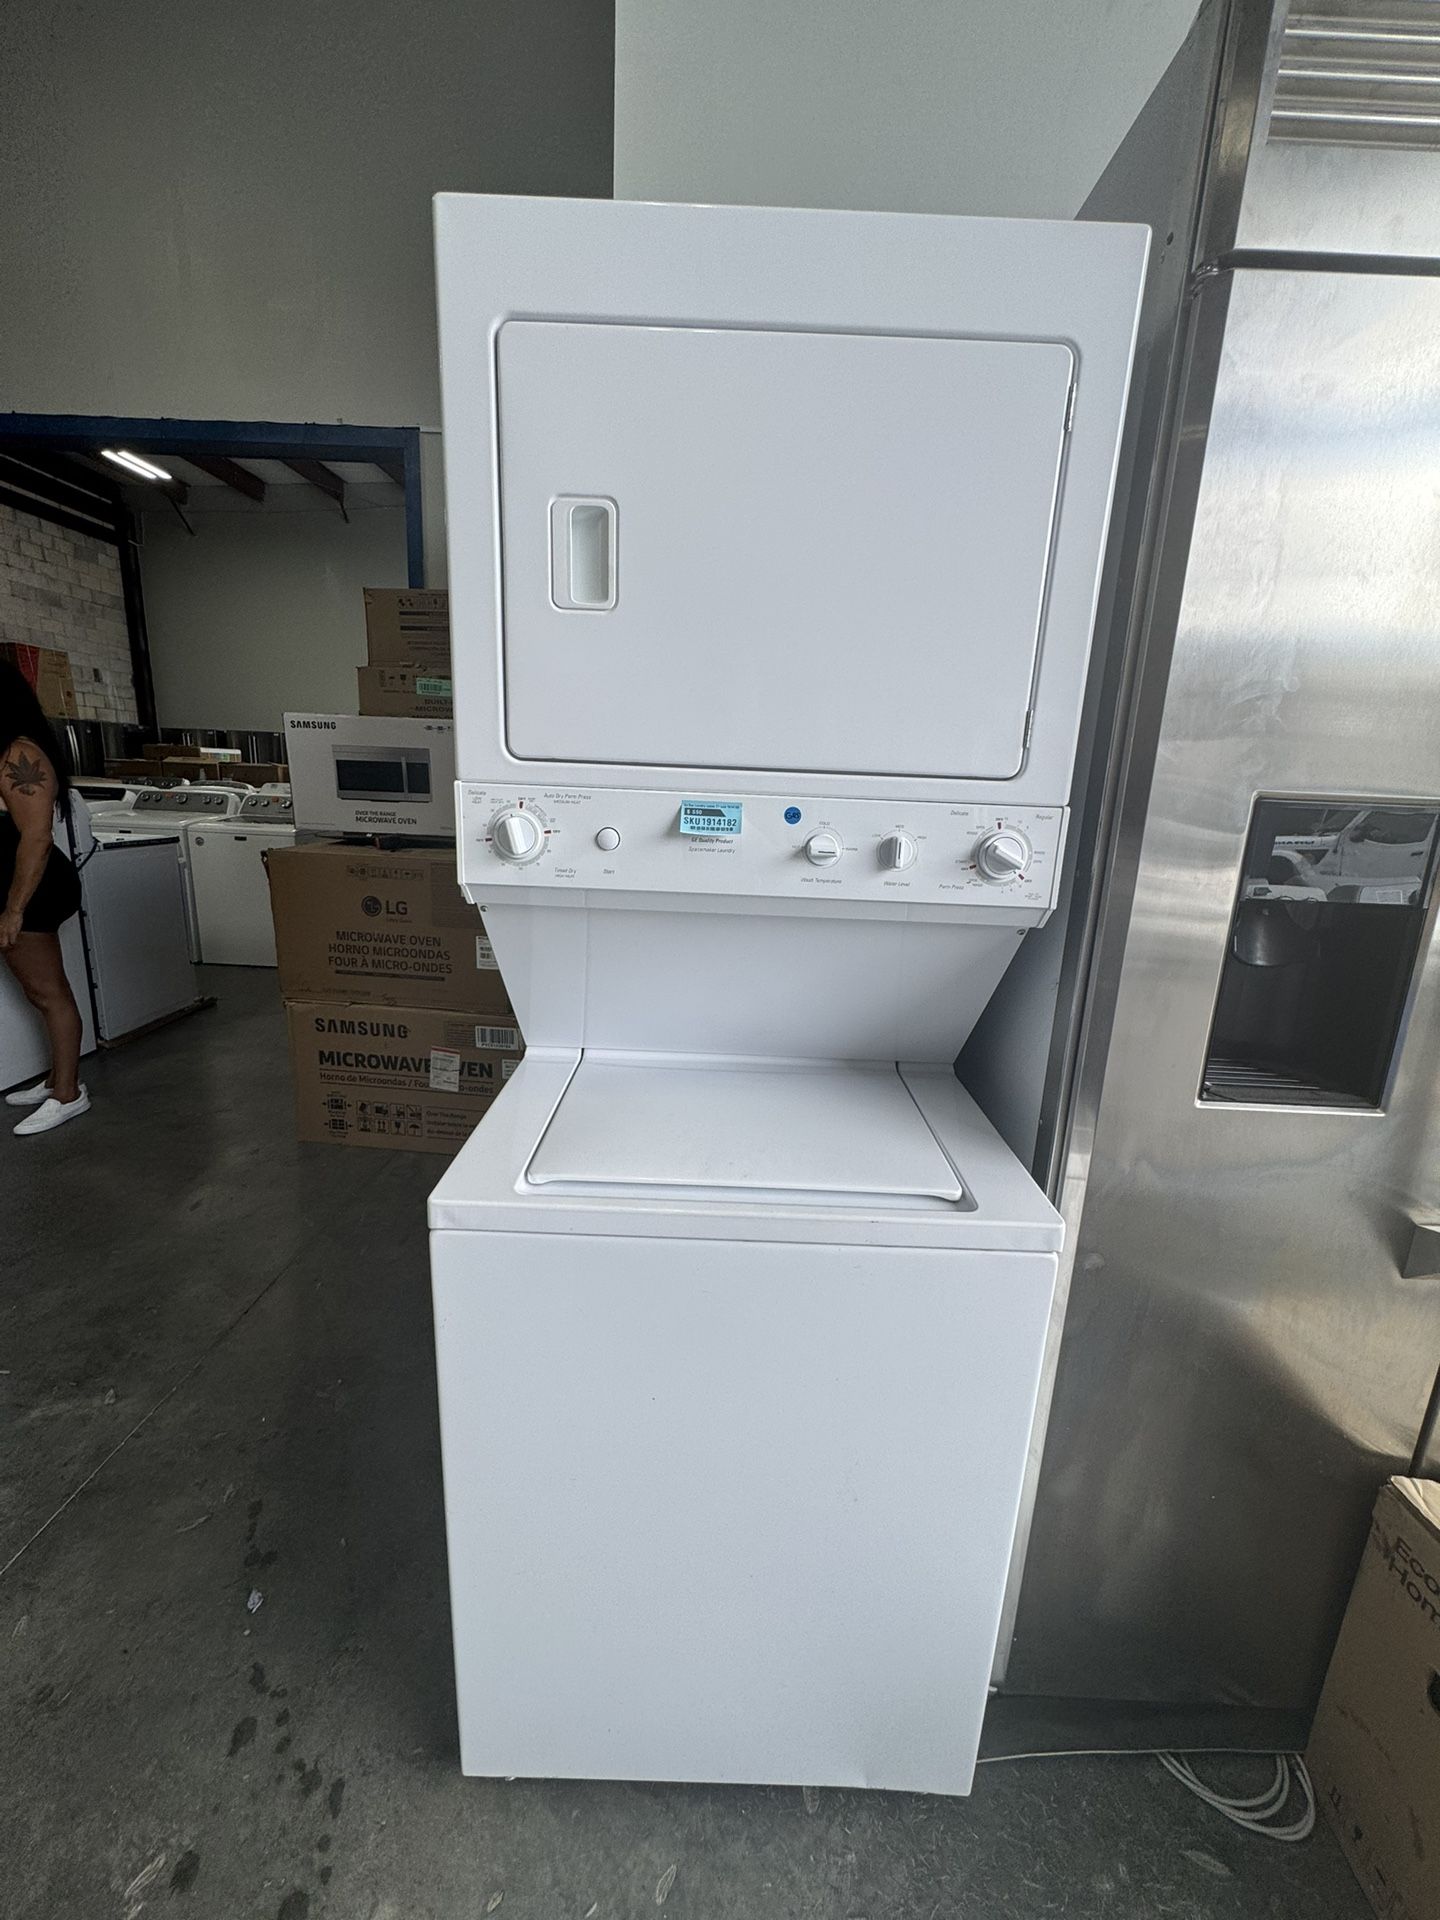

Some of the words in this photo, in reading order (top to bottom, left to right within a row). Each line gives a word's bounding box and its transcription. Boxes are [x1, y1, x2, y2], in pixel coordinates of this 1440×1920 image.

[290, 720, 337, 730] SAMSUNG
[355, 816, 397, 824] MICROWAVE
[397, 817, 417, 825] OVEN
[386, 900, 408, 915] LG
[335, 931, 407, 945] MICROWAVE
[409, 935, 441, 947] OVEN
[328, 943, 370, 956] HORNO
[372, 945, 450, 960] MICROONDAS
[328, 956, 358, 968] FOUR
[360, 955, 369, 968] À
[371, 959, 453, 974] MICRO-ONDES
[314, 1017, 409, 1039] SAMSUNG
[318, 1050, 431, 1073] MICROWAVE
[459, 1061, 493, 1079] VEN
[320, 1072, 345, 1081] Horno
[346, 1073, 357, 1082] de
[359, 1074, 407, 1087] Microondas
[414, 1079, 430, 1089] Fou
